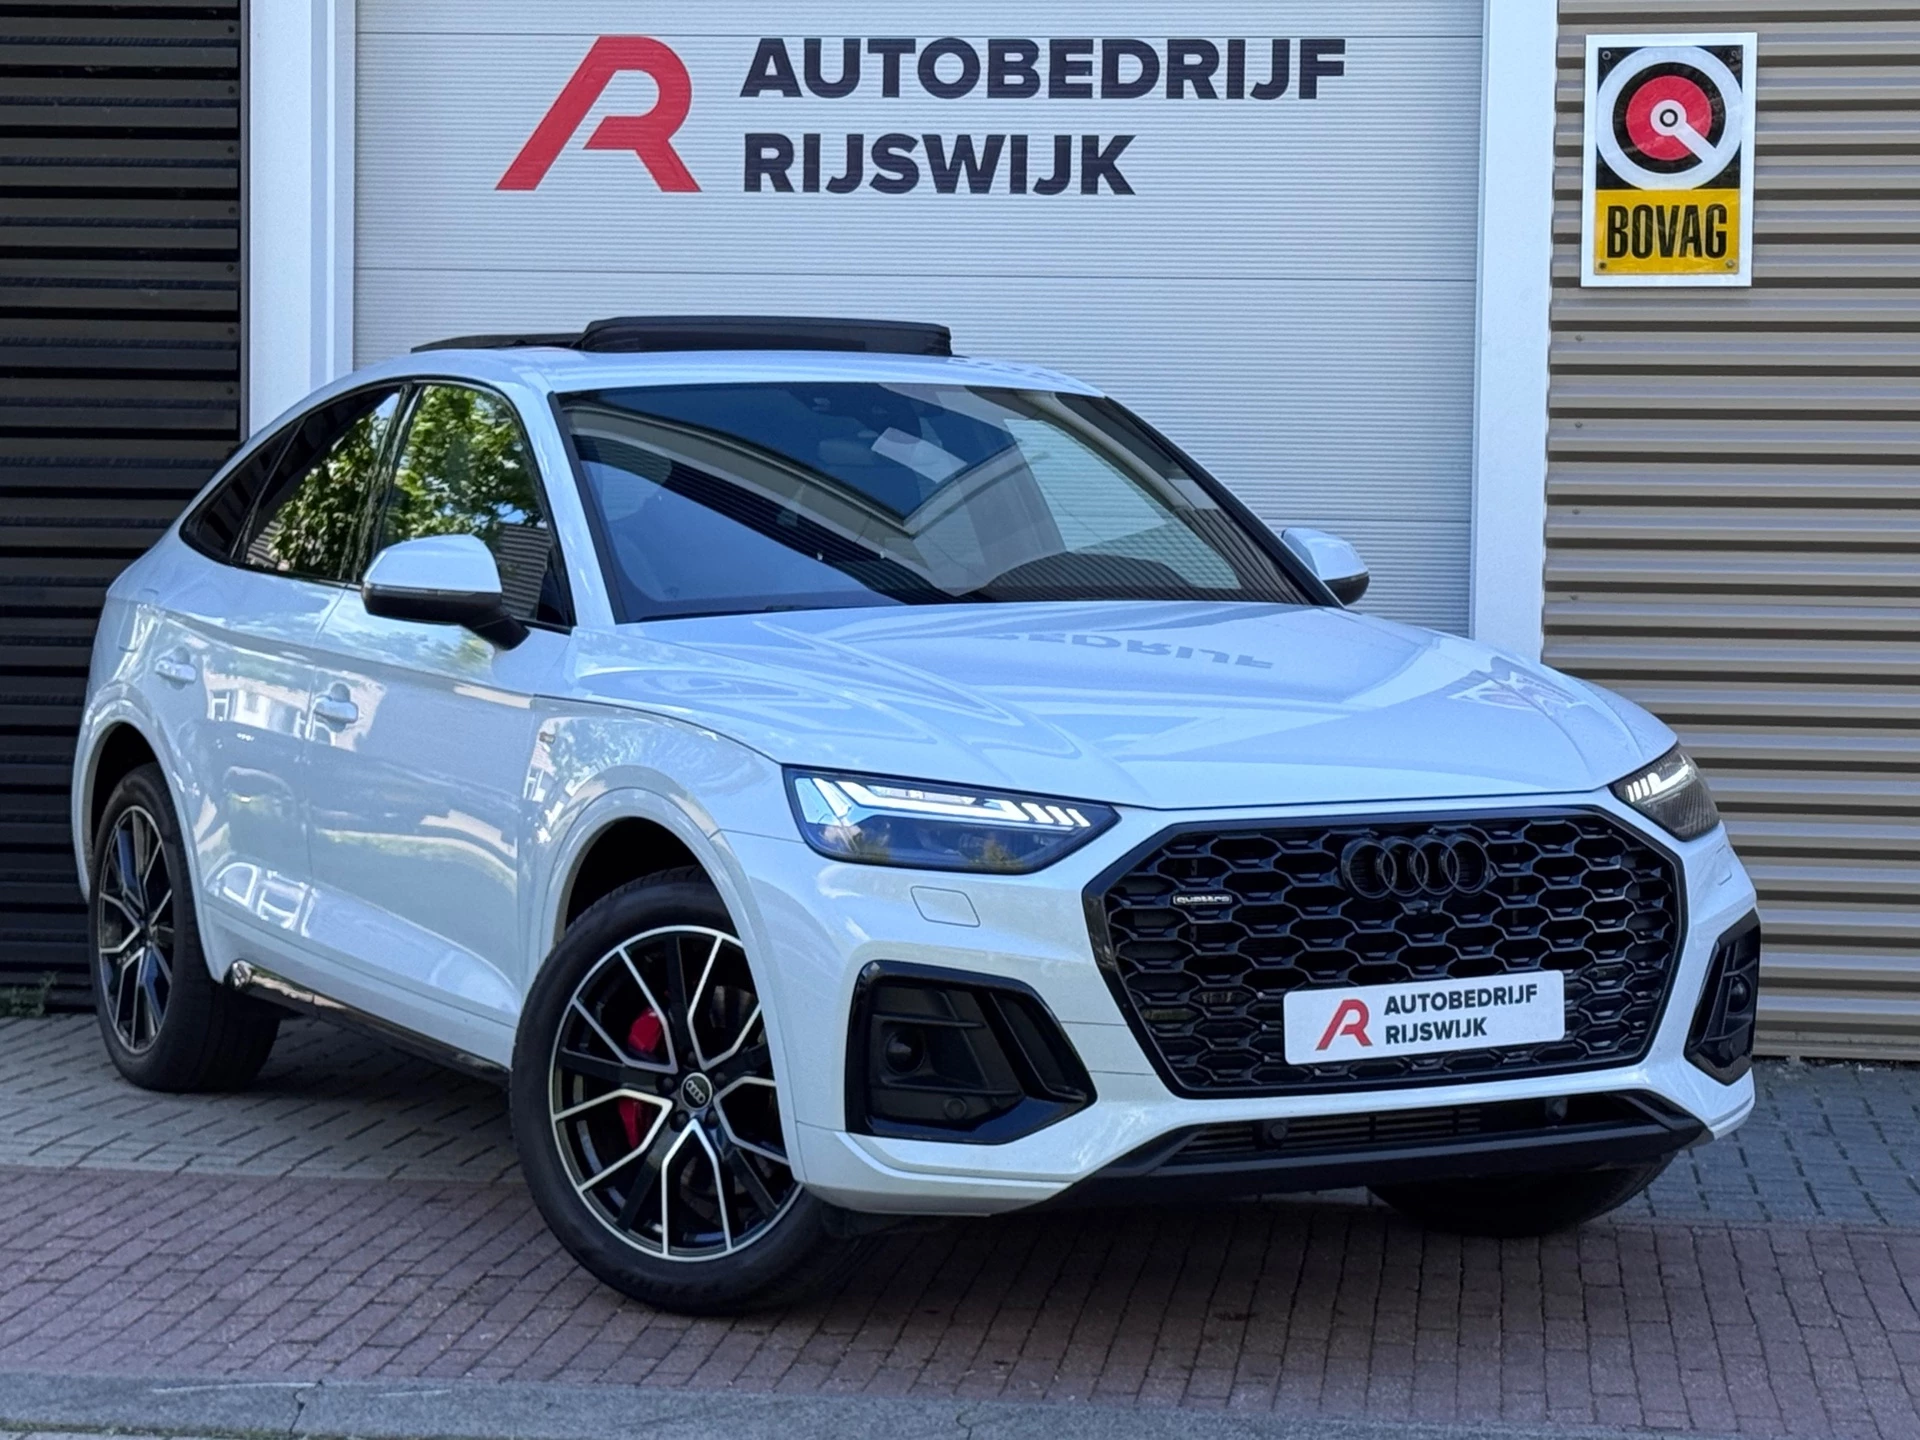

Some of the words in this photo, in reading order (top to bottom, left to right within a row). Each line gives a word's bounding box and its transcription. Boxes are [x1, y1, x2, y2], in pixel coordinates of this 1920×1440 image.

[740, 36, 1346, 100] AUTOBEDRIJF
[744, 132, 1136, 197] RIJSWIJK
[1606, 203, 1728, 259] BOVAG
[1384, 984, 1538, 1016] AUTOBEDRIJF
[1385, 1017, 1487, 1045] RIJSWIJK
